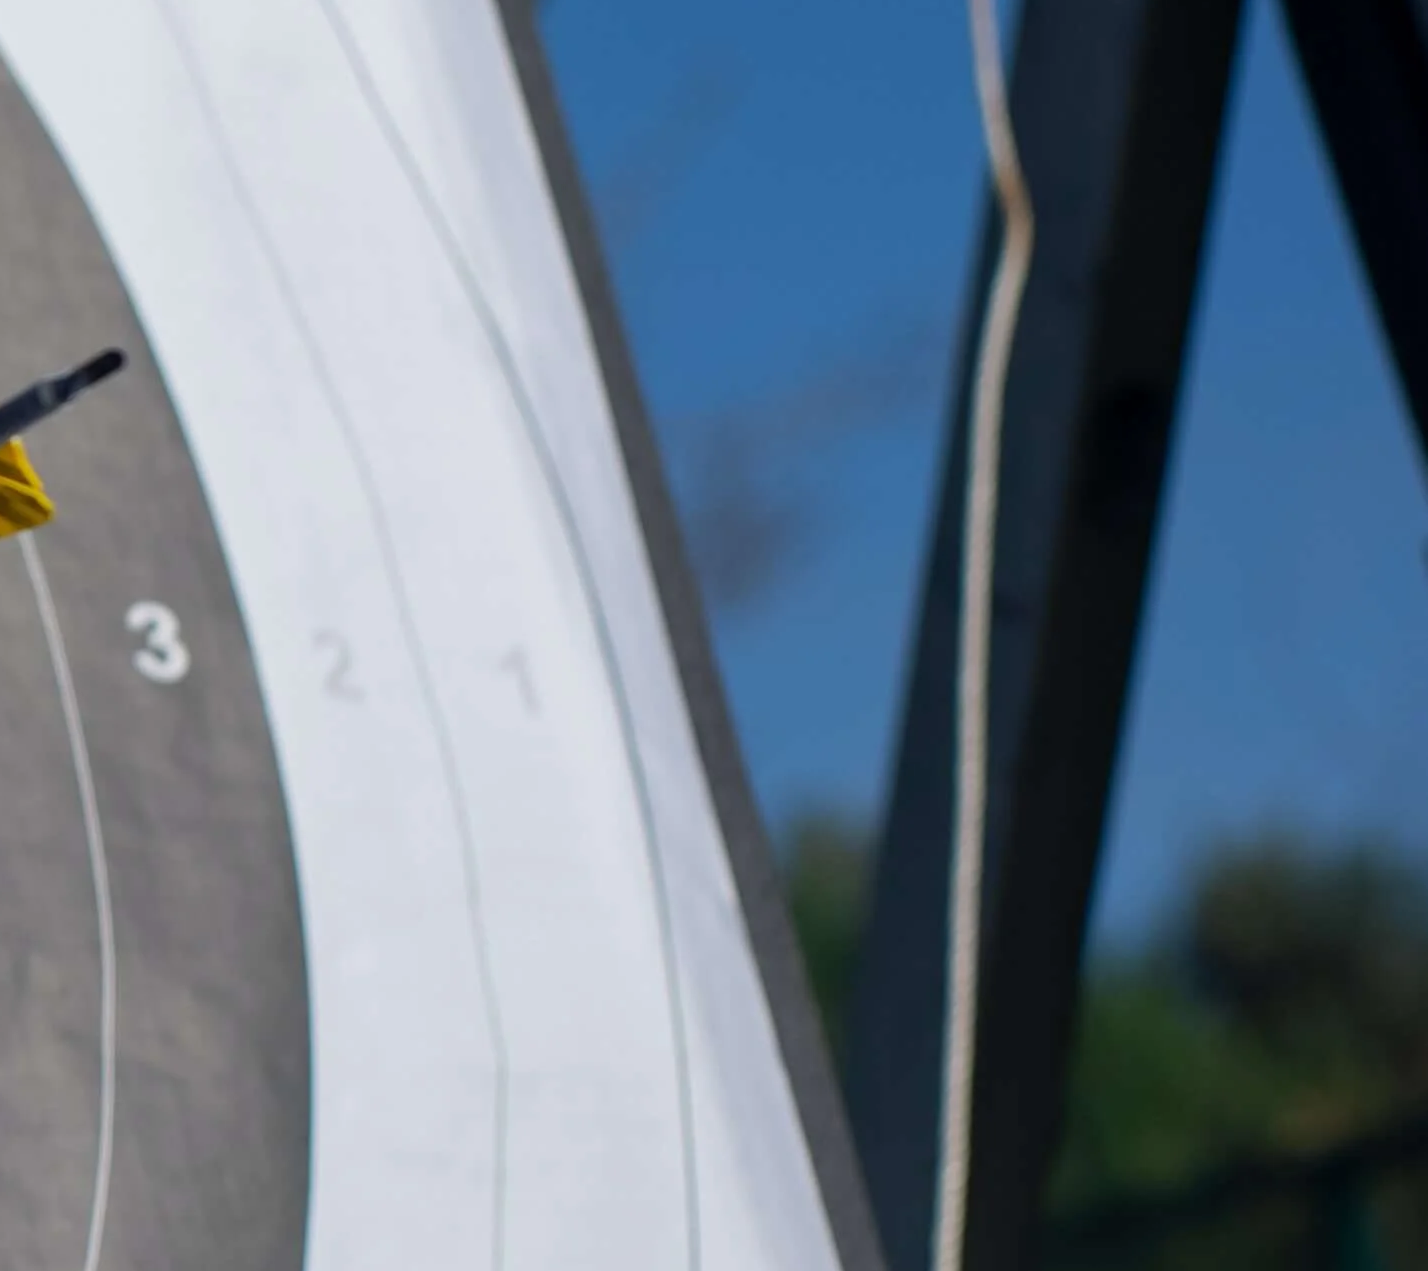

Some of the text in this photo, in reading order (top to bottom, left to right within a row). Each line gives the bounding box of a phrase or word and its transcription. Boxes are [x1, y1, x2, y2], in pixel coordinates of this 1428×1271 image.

[127, 603, 188, 680] 3
[312, 628, 365, 704] 2
[496, 644, 541, 717] 1
